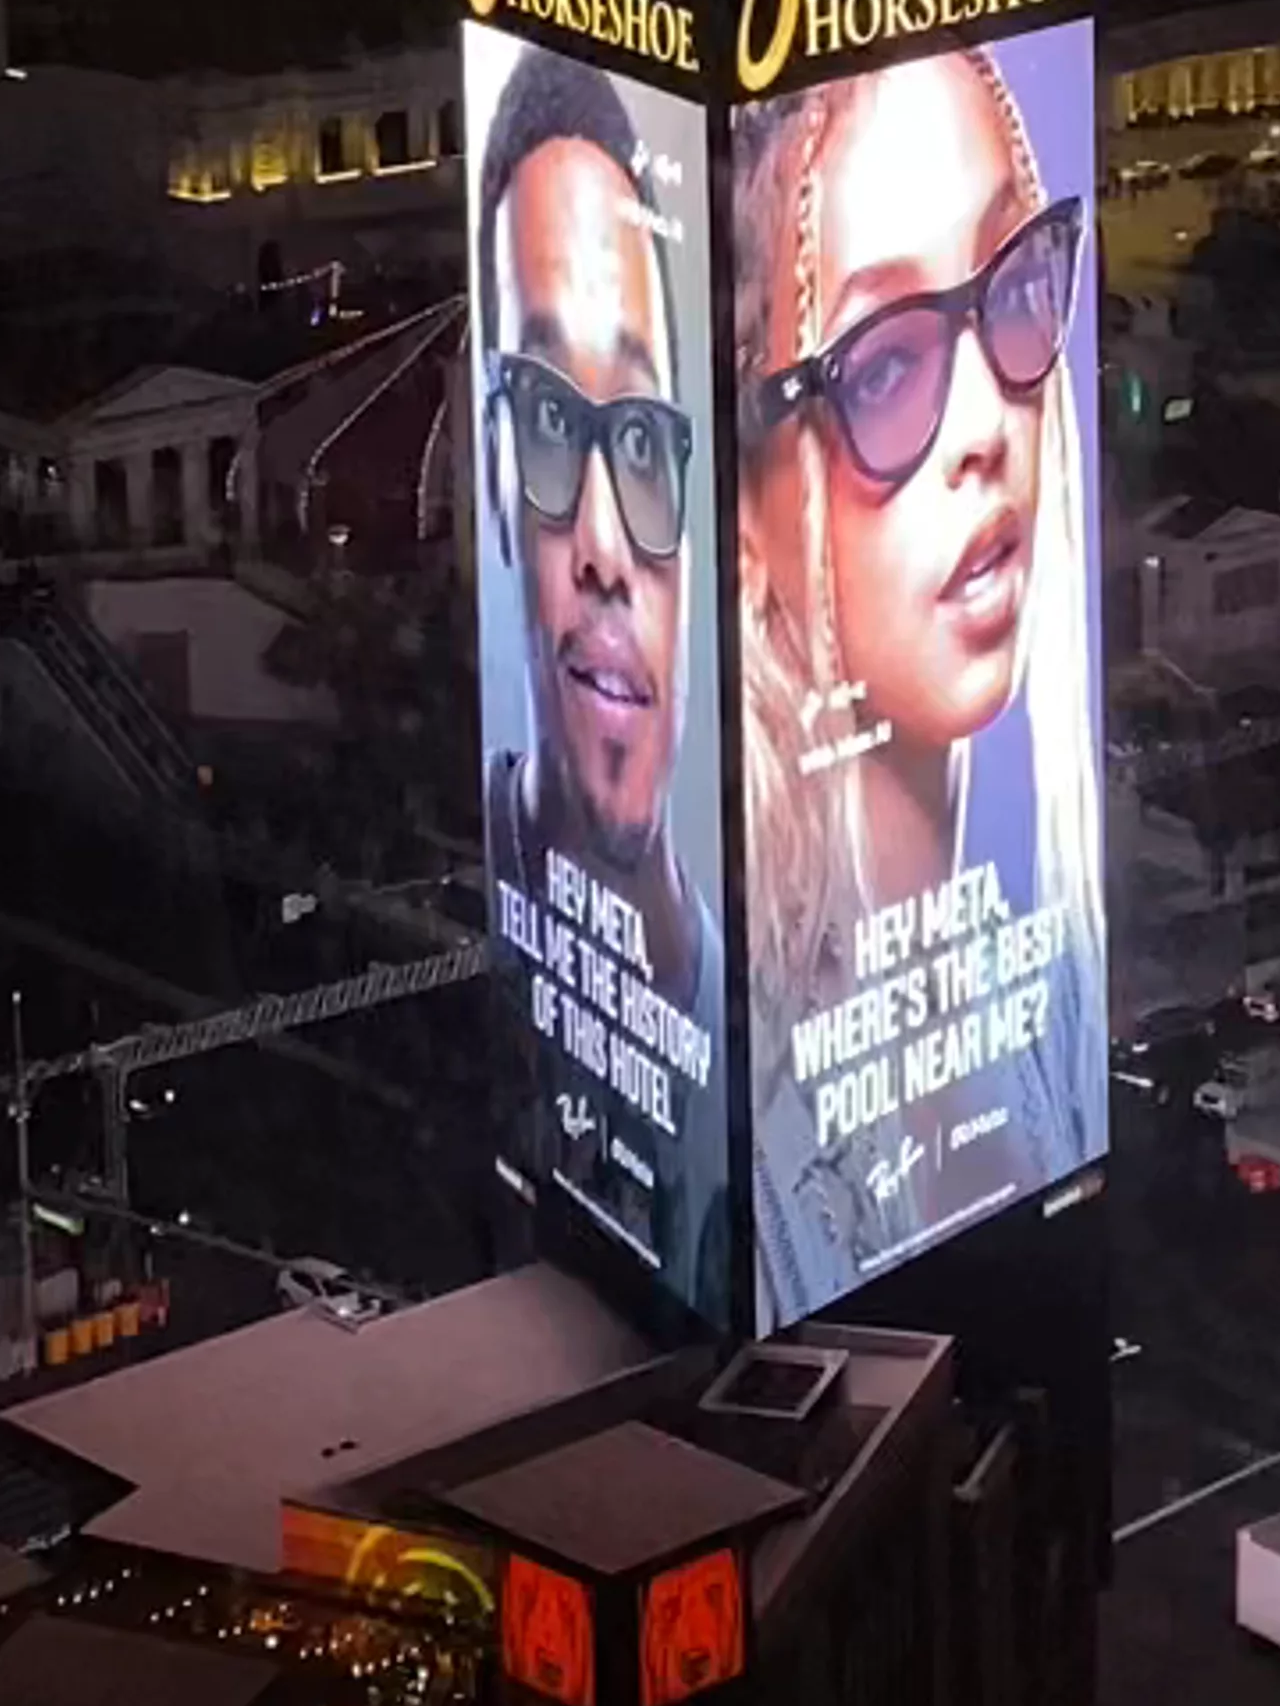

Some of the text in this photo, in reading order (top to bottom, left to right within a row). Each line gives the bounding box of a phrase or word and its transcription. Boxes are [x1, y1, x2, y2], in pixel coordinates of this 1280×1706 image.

[498, 879, 711, 1088] TELL ME THE HISTORY
[546, 847, 654, 984] HEY META,
[854, 860, 1010, 980] HEY META,
[531, 973, 558, 1038] OF
[559, 991, 608, 1080] THIS
[790, 904, 1066, 1083] WHERE'S THE BEST
[815, 1054, 899, 1148] POOL
[903, 1012, 983, 1104] NEAR
[986, 978, 1050, 1063] ME?
